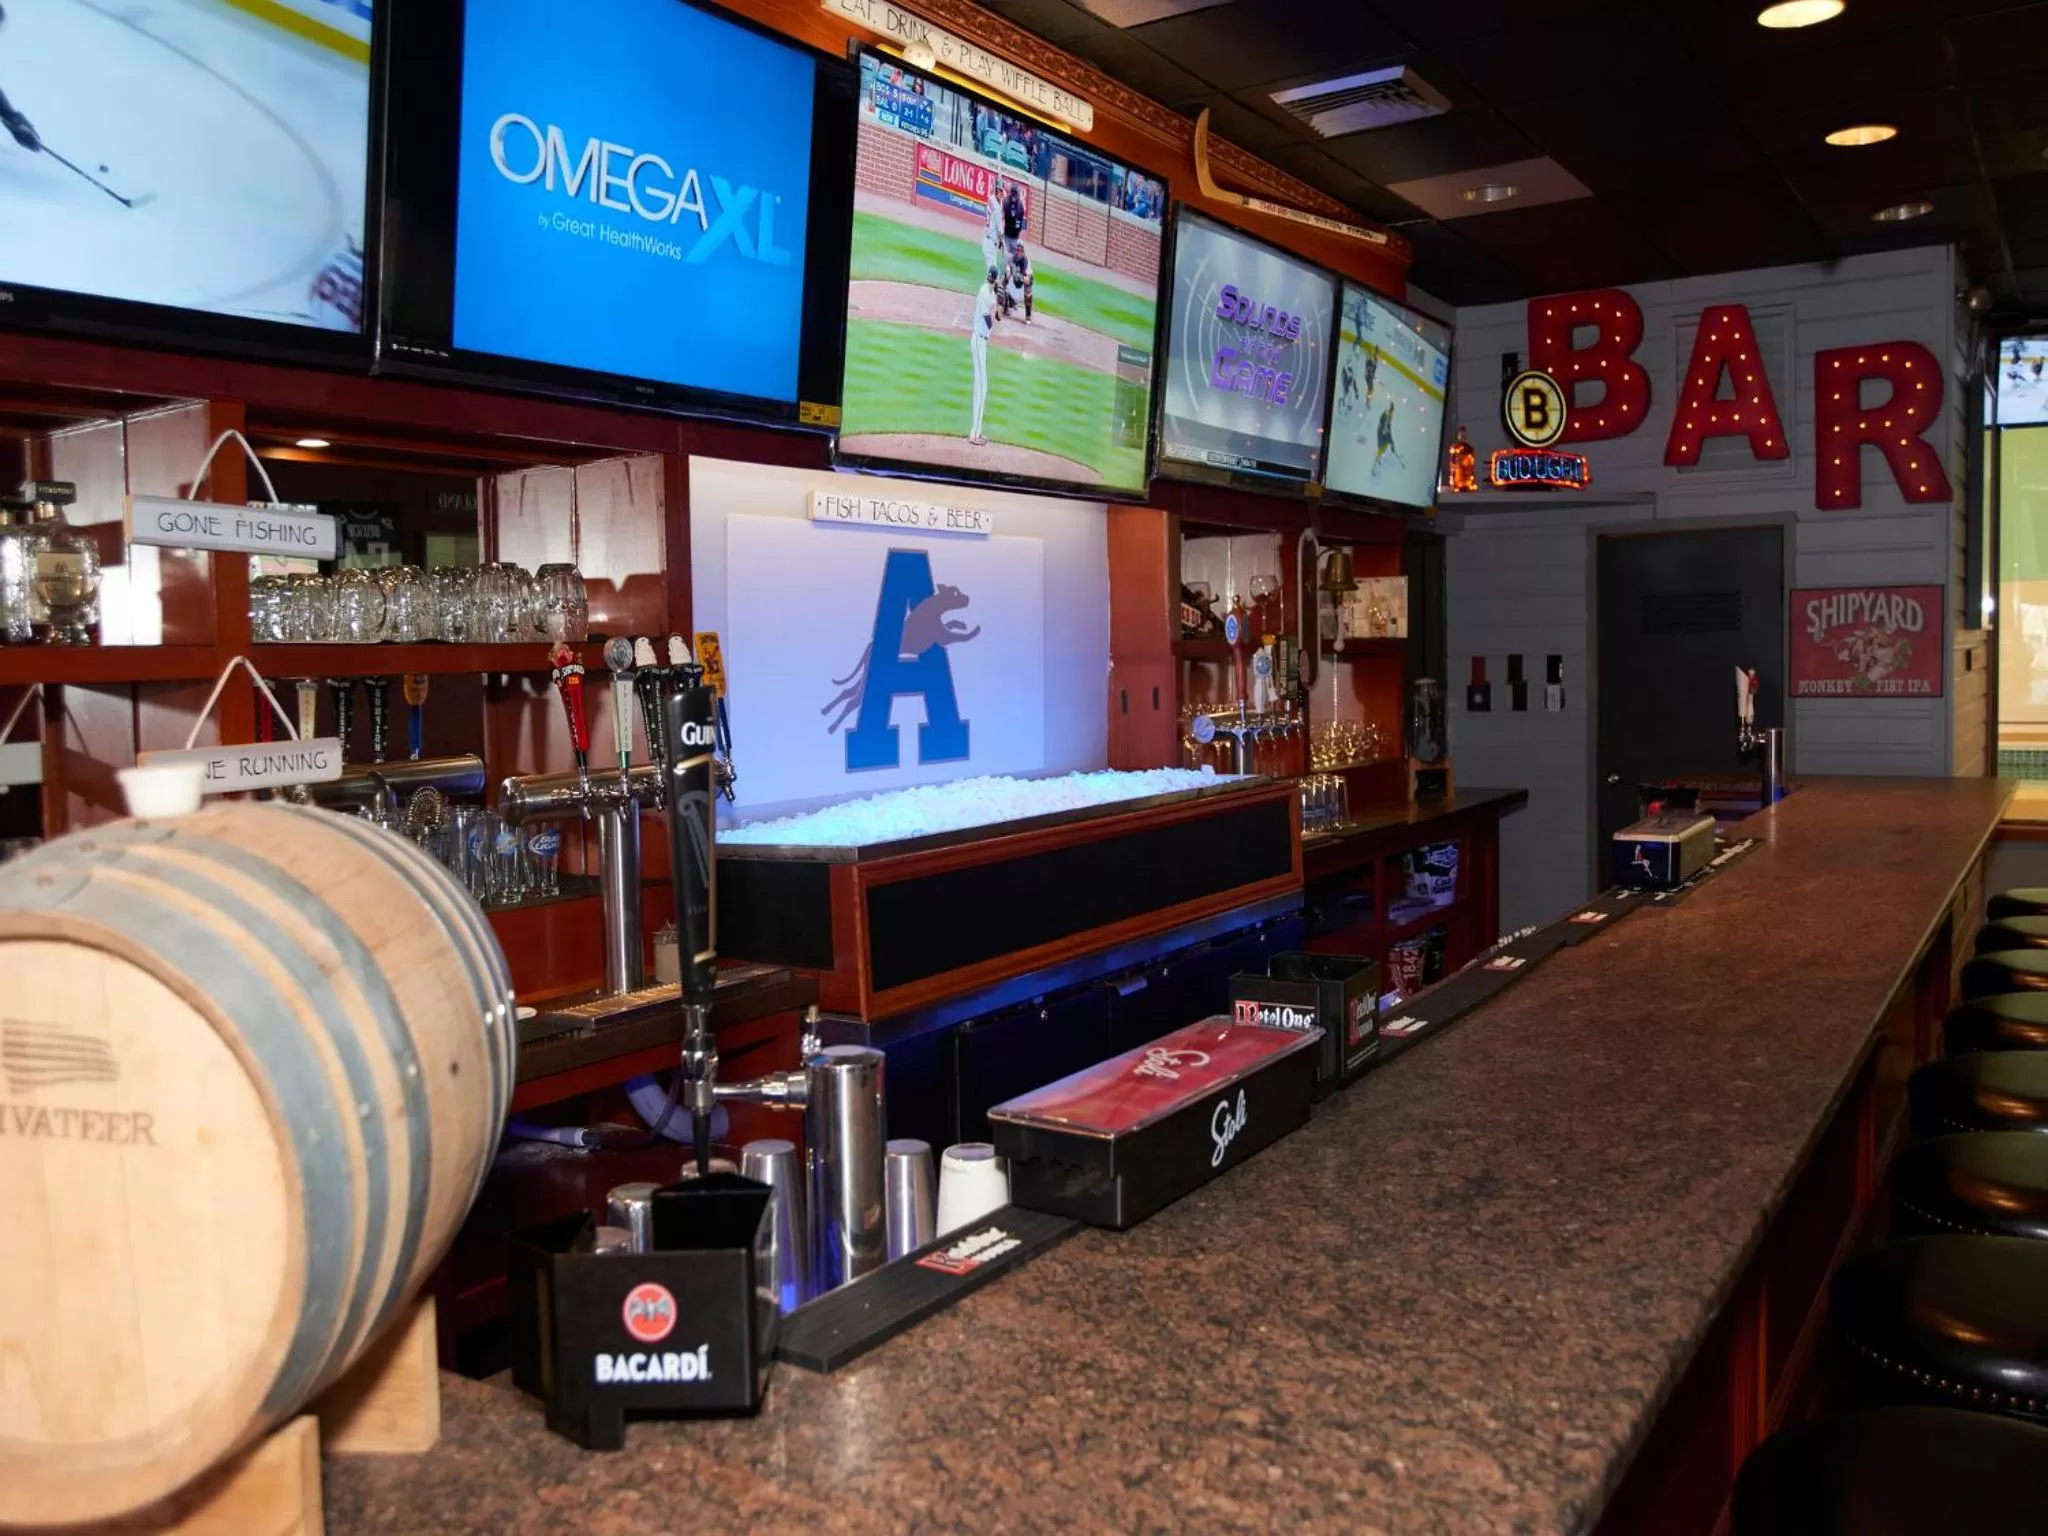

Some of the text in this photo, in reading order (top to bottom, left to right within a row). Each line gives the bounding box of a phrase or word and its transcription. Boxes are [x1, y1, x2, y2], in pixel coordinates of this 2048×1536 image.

[886, 8, 931, 42] DRINK
[941, 36, 952, 57] &
[960, 44, 995, 77] PLAY
[1001, 65, 1046, 105] WIFFLE
[1053, 91, 1085, 122] BALL
[944, 157, 974, 192] LONG
[976, 170, 985, 195] &
[538, 212, 683, 261] by Great HealthWorks
[1522, 387, 1549, 430] B
[1527, 289, 1953, 512] BAR
[158, 512, 223, 536] GONE
[235, 519, 317, 546] FISHING
[826, 496, 982, 530] FISH TACOS & BEER
[1806, 591, 1924, 642] SHIPYARD
[1798, 680, 1853, 693] MONKEY
[1908, 679, 1931, 693] IPA
[240, 751, 327, 776] RUNNING
[1210, 1087, 1247, 1168] Stoli
[596, 1343, 712, 1383] BACARDÍ
